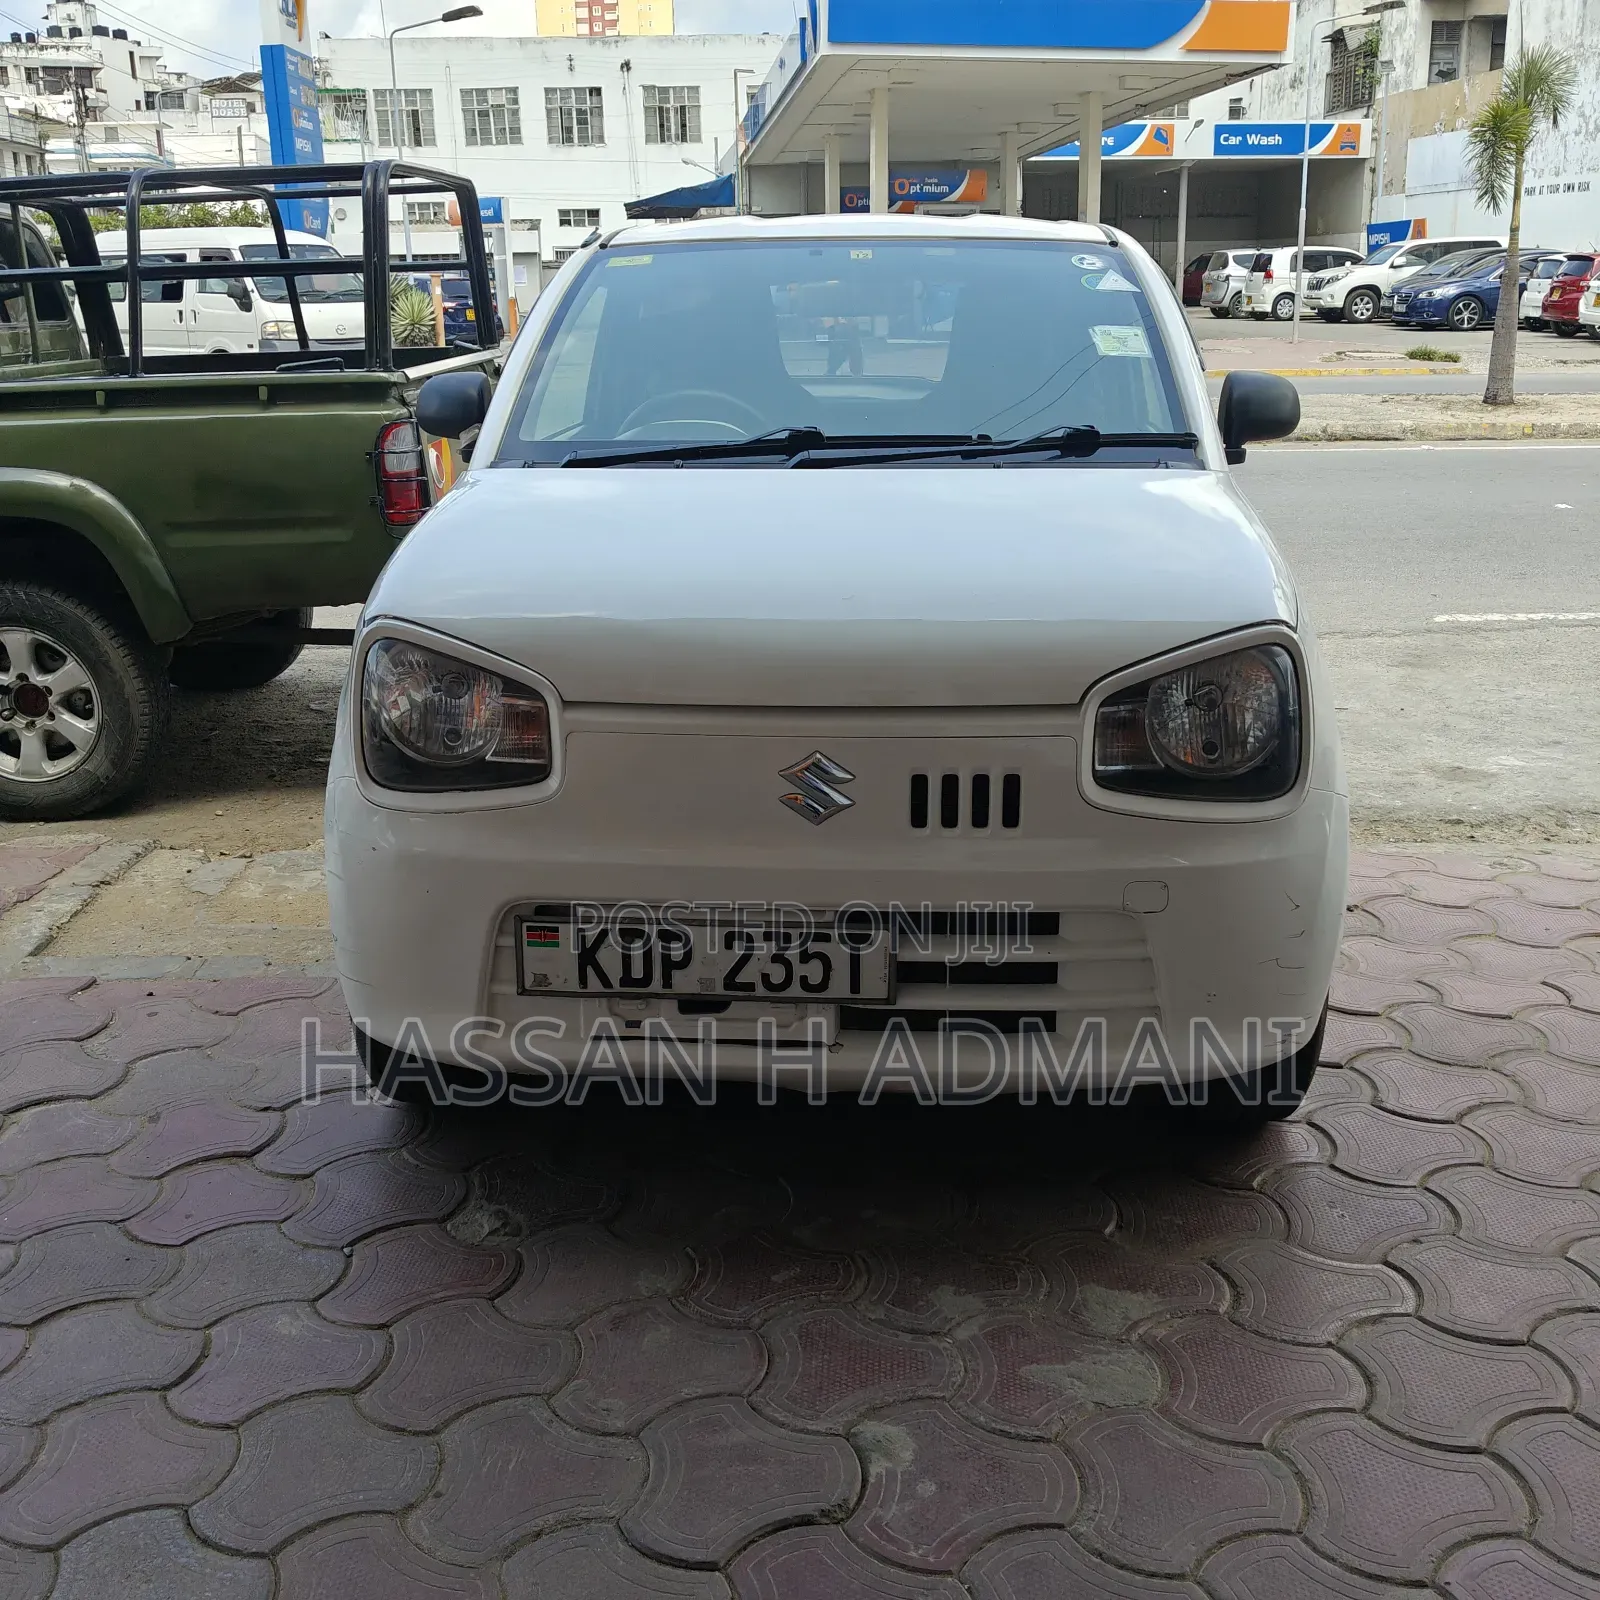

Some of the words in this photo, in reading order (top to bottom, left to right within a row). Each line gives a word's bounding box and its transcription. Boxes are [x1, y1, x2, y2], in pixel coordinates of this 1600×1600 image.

[1219, 133, 1243, 145] Car
[1246, 133, 1283, 145] Wash
[1524, 186, 1537, 196] PARK
[1539, 185, 1545, 195] AT
[1547, 184, 1561, 195] YOUR
[1563, 182, 1576, 194] OWN
[1578, 181, 1592, 193] RISK
[481, 206, 494, 217] esel
[577, 926, 694, 990] KDP
[722, 929, 874, 995] 235T
